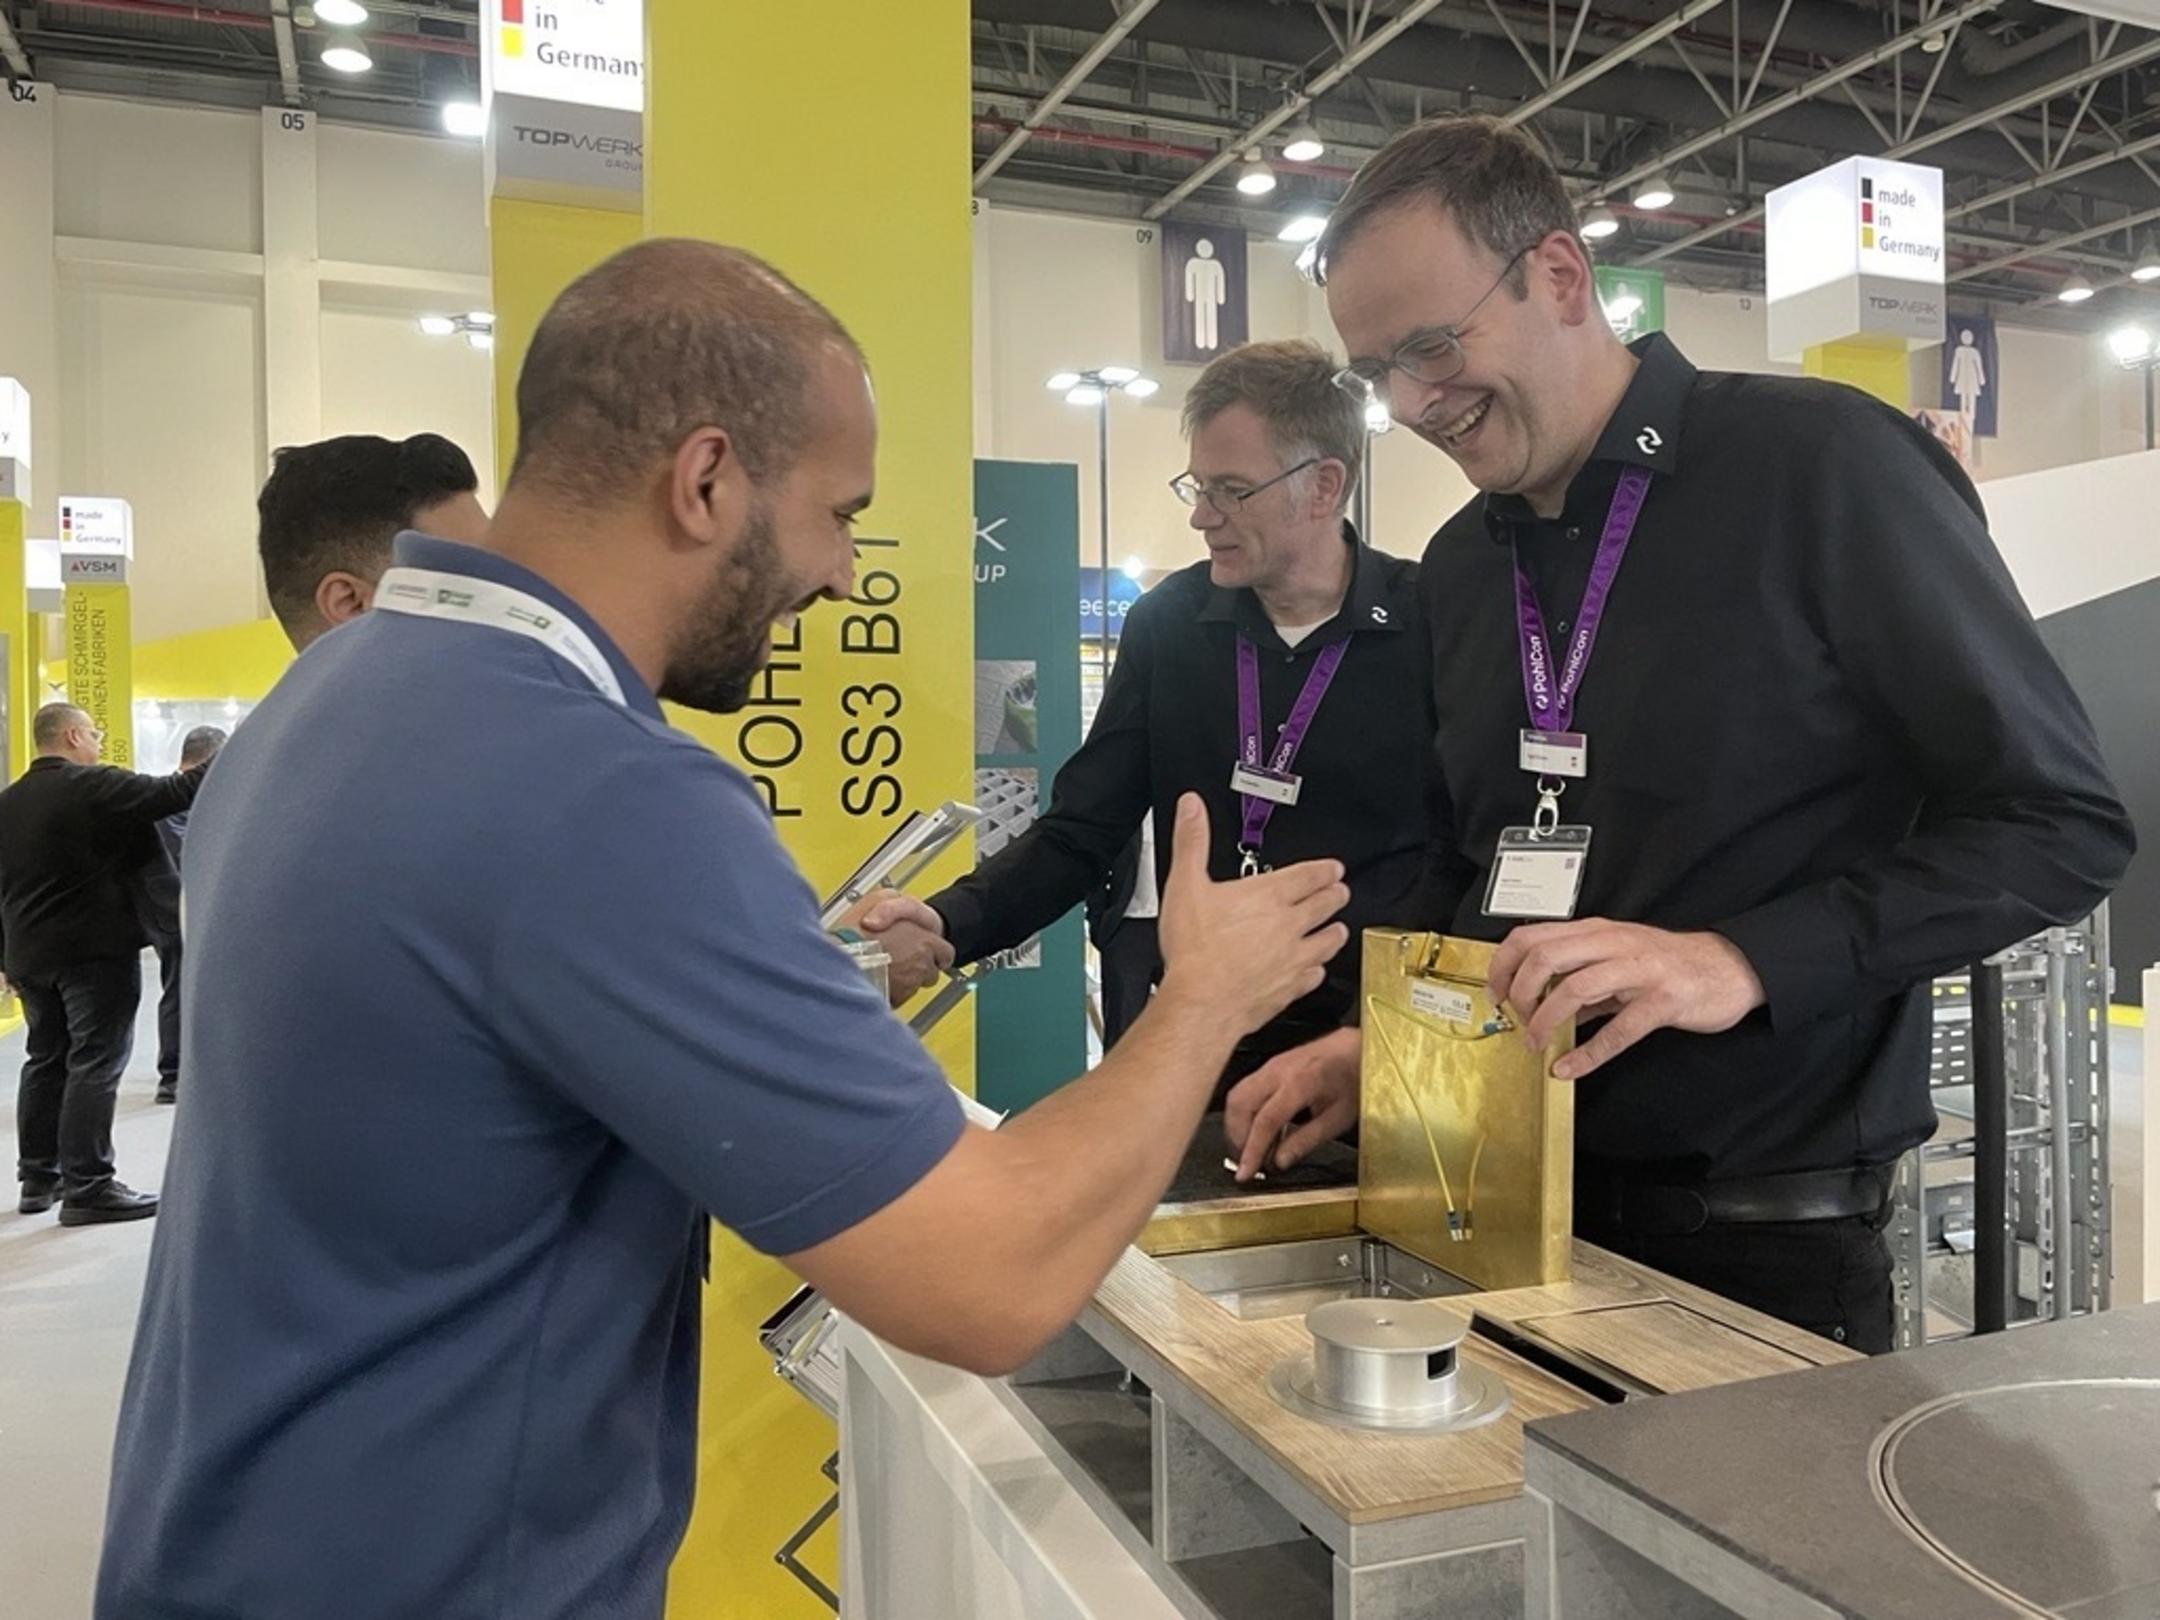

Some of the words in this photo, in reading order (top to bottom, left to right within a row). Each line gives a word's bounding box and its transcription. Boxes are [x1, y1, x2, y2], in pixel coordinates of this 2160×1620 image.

[535, 6, 558, 30] in
[537, 42, 643, 77] German
[282, 112, 305, 131] 05
[513, 125, 643, 156] TOPWERK
[1878, 189, 1916, 207] made
[1878, 210, 1891, 227] in
[1136, 229, 1152, 244] 09
[1878, 236, 1941, 262] Germany
[80, 560, 117, 573] VSM
[841, 538, 900, 654] B61
[1079, 598, 1129, 617] eece
[1530, 635, 1549, 693] PohlCon
[113, 738, 127, 763] B50
[841, 683, 902, 817] SS3
